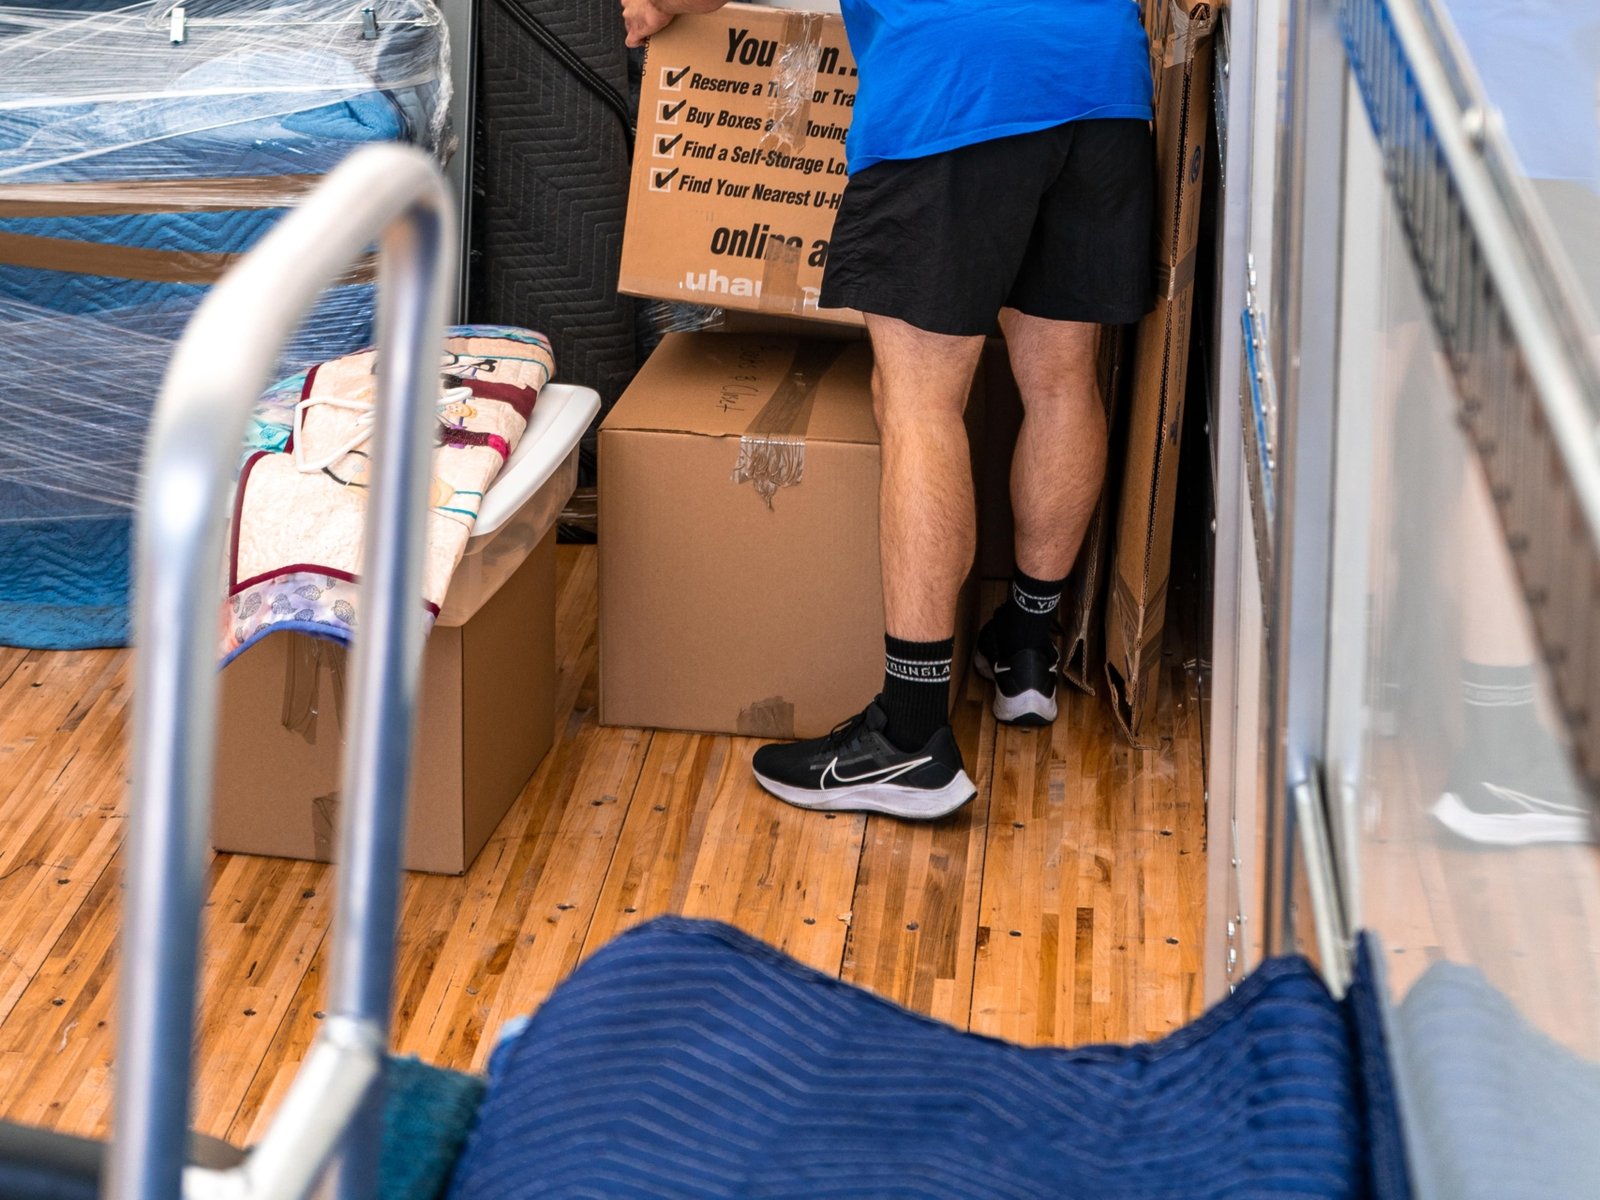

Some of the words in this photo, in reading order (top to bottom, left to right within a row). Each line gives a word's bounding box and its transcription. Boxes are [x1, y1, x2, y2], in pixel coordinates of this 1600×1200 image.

[725, 27, 778, 68] You
[689, 72, 750, 96] Reserve
[752, 81, 762, 97] a
[812, 89, 830, 104] or
[686, 106, 714, 128] Buy
[716, 110, 762, 132] Boxes
[681, 141, 717, 160] Find
[717, 147, 728, 162] a
[731, 146, 824, 175] Self-Storage
[678, 174, 713, 194] Find
[716, 179, 750, 199] Your
[752, 183, 811, 207] Nearest
